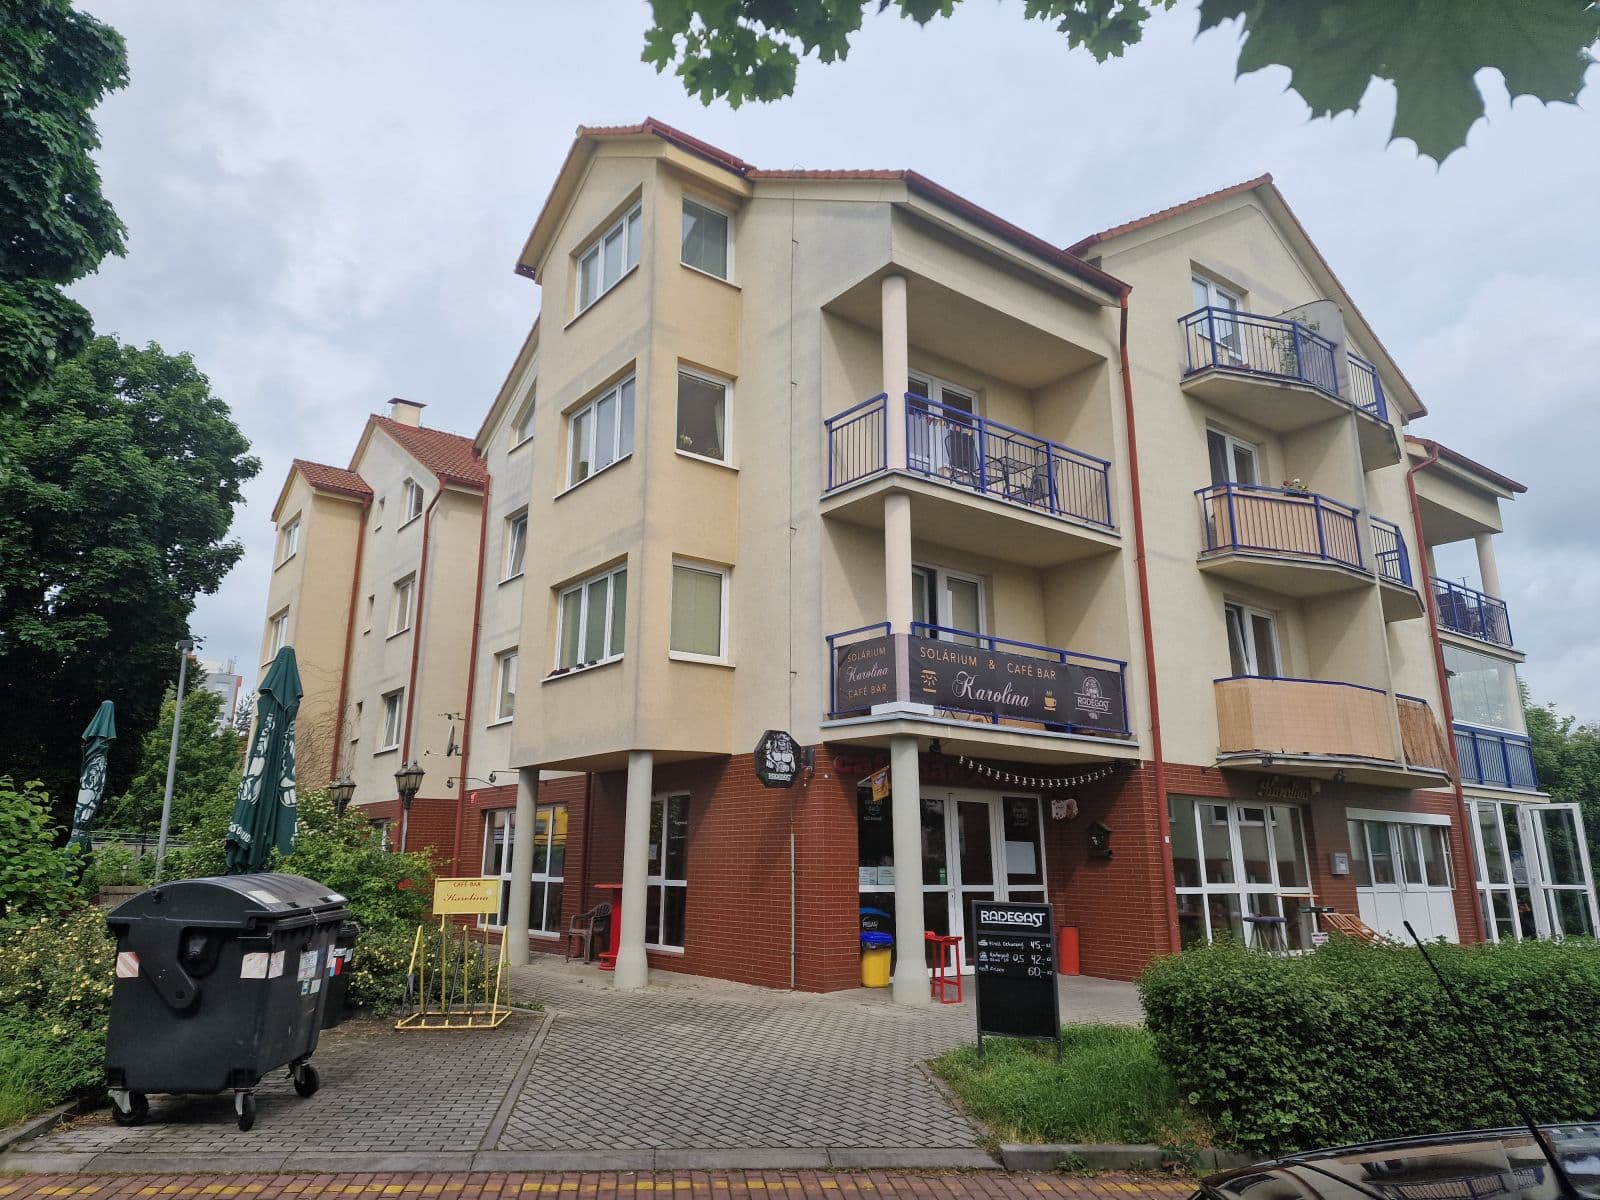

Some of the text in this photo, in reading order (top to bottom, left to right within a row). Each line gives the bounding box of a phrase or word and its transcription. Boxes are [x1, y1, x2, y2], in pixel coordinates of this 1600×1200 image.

[847, 662, 889, 683] Karolina
[920, 646, 1056, 680] SOLÁRIUM & CAFÉ BAR
[848, 683, 887, 699] CAFÉ BAR
[951, 670, 1031, 707] Karolina
[980, 910, 1046, 928] RADEGAST
